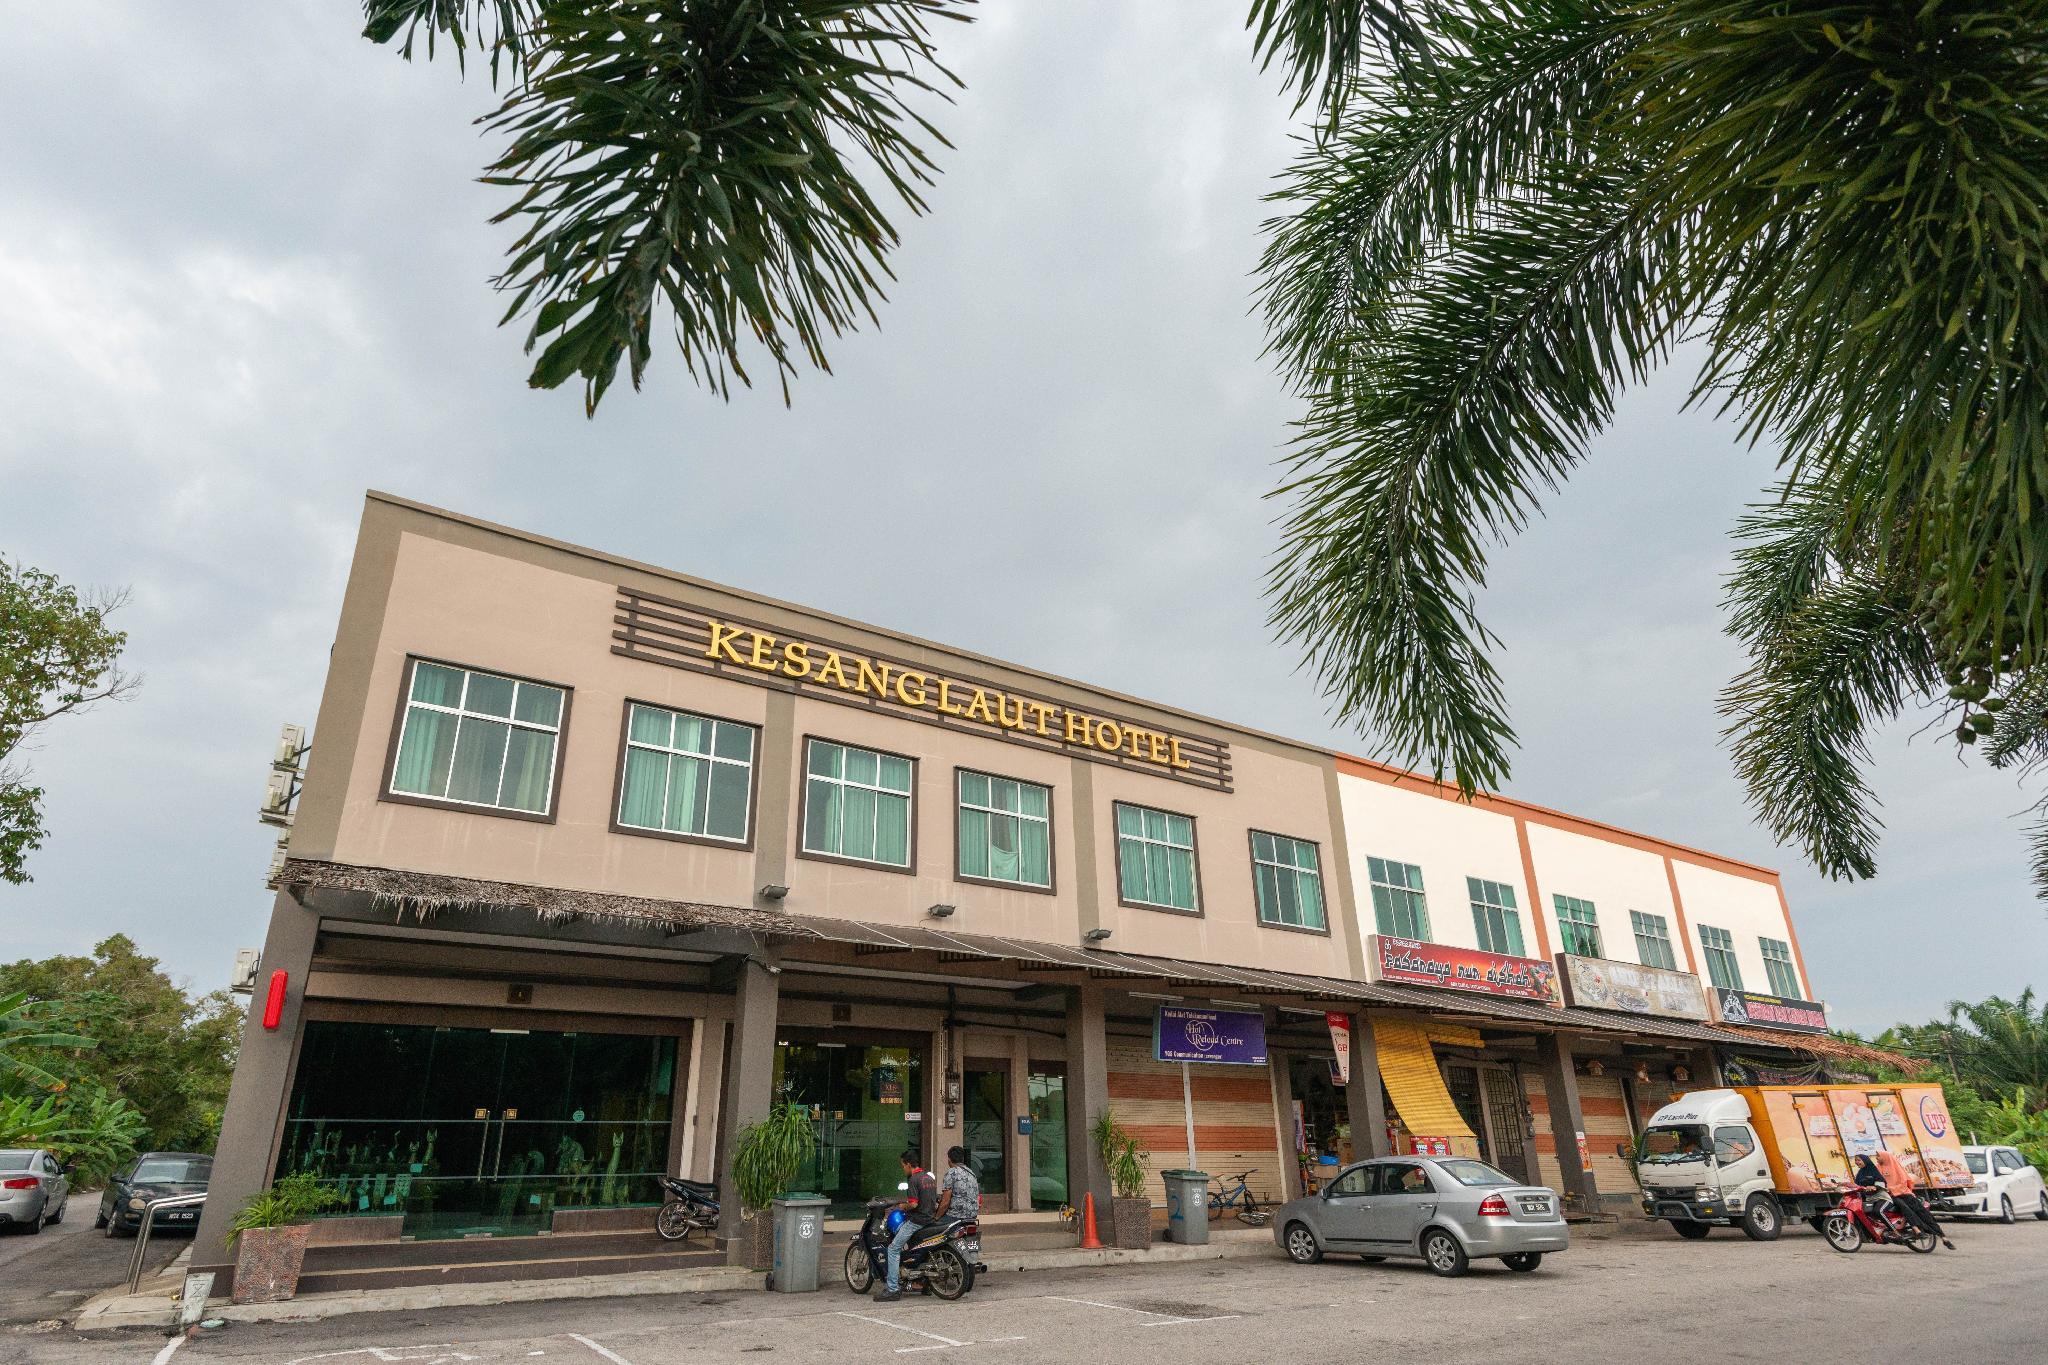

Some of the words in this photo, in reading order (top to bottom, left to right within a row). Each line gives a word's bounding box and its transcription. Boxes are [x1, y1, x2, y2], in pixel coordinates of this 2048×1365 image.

[705, 621, 926, 707] KESANG
[937, 679, 1054, 736] LAUT
[1063, 711, 1191, 769] HOTEL
[1186, 1023, 1201, 1034] Hot
[1220, 1035, 1243, 1047] Centre
[1925, 1113, 1947, 1130] LTP
